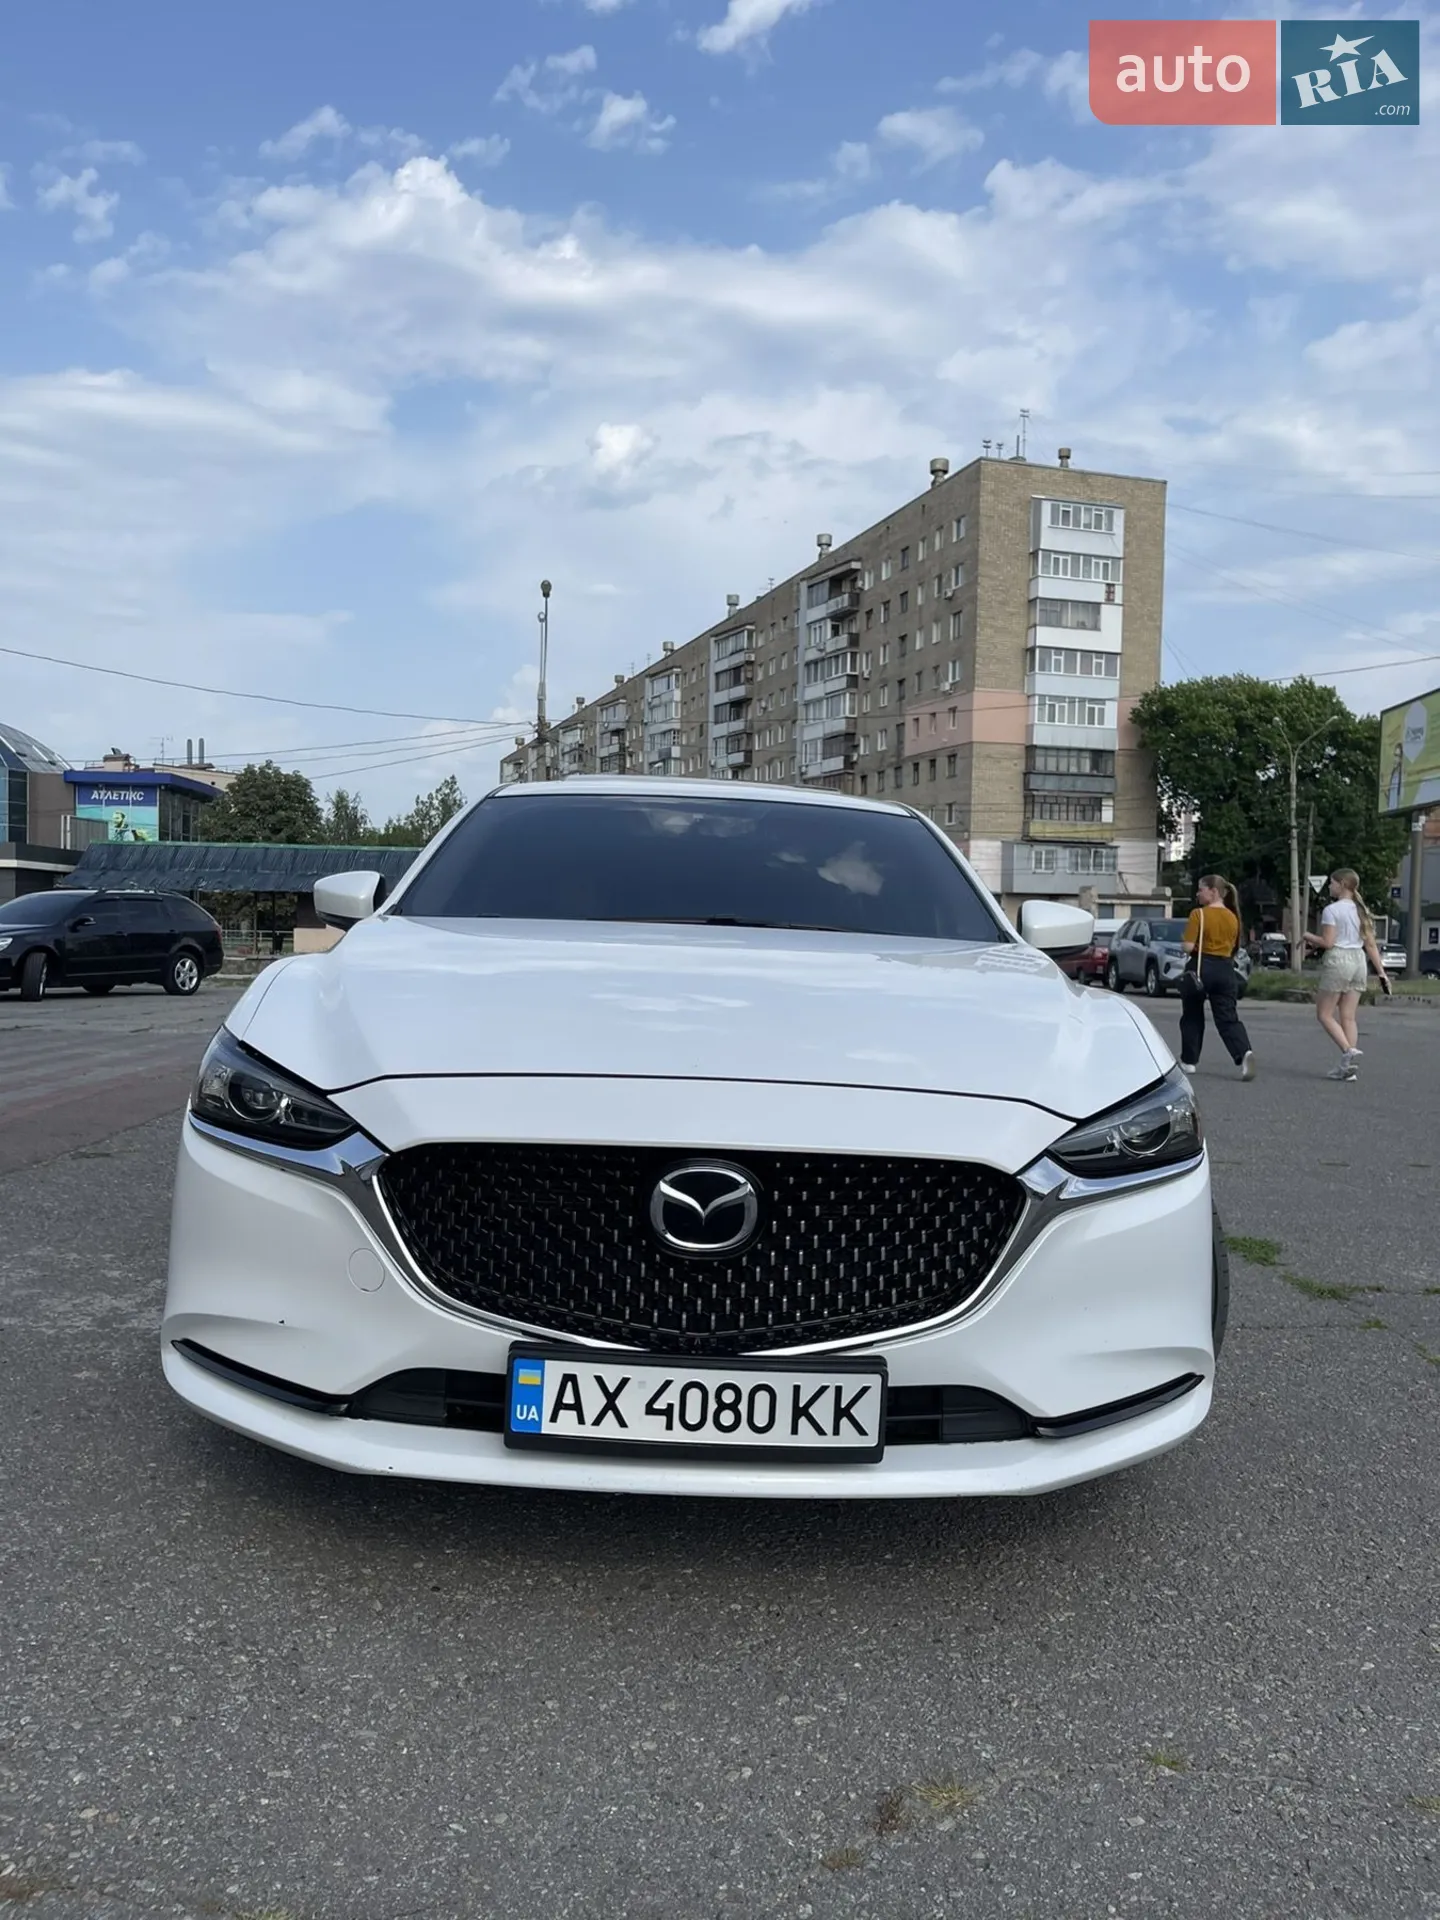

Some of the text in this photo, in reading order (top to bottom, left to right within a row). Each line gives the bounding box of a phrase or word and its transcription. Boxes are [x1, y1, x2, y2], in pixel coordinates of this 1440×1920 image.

[91, 790, 145, 801] АТЛЕТІКС
[516, 1403, 540, 1423] UA
[549, 1373, 872, 1437] AX 4080 KK
